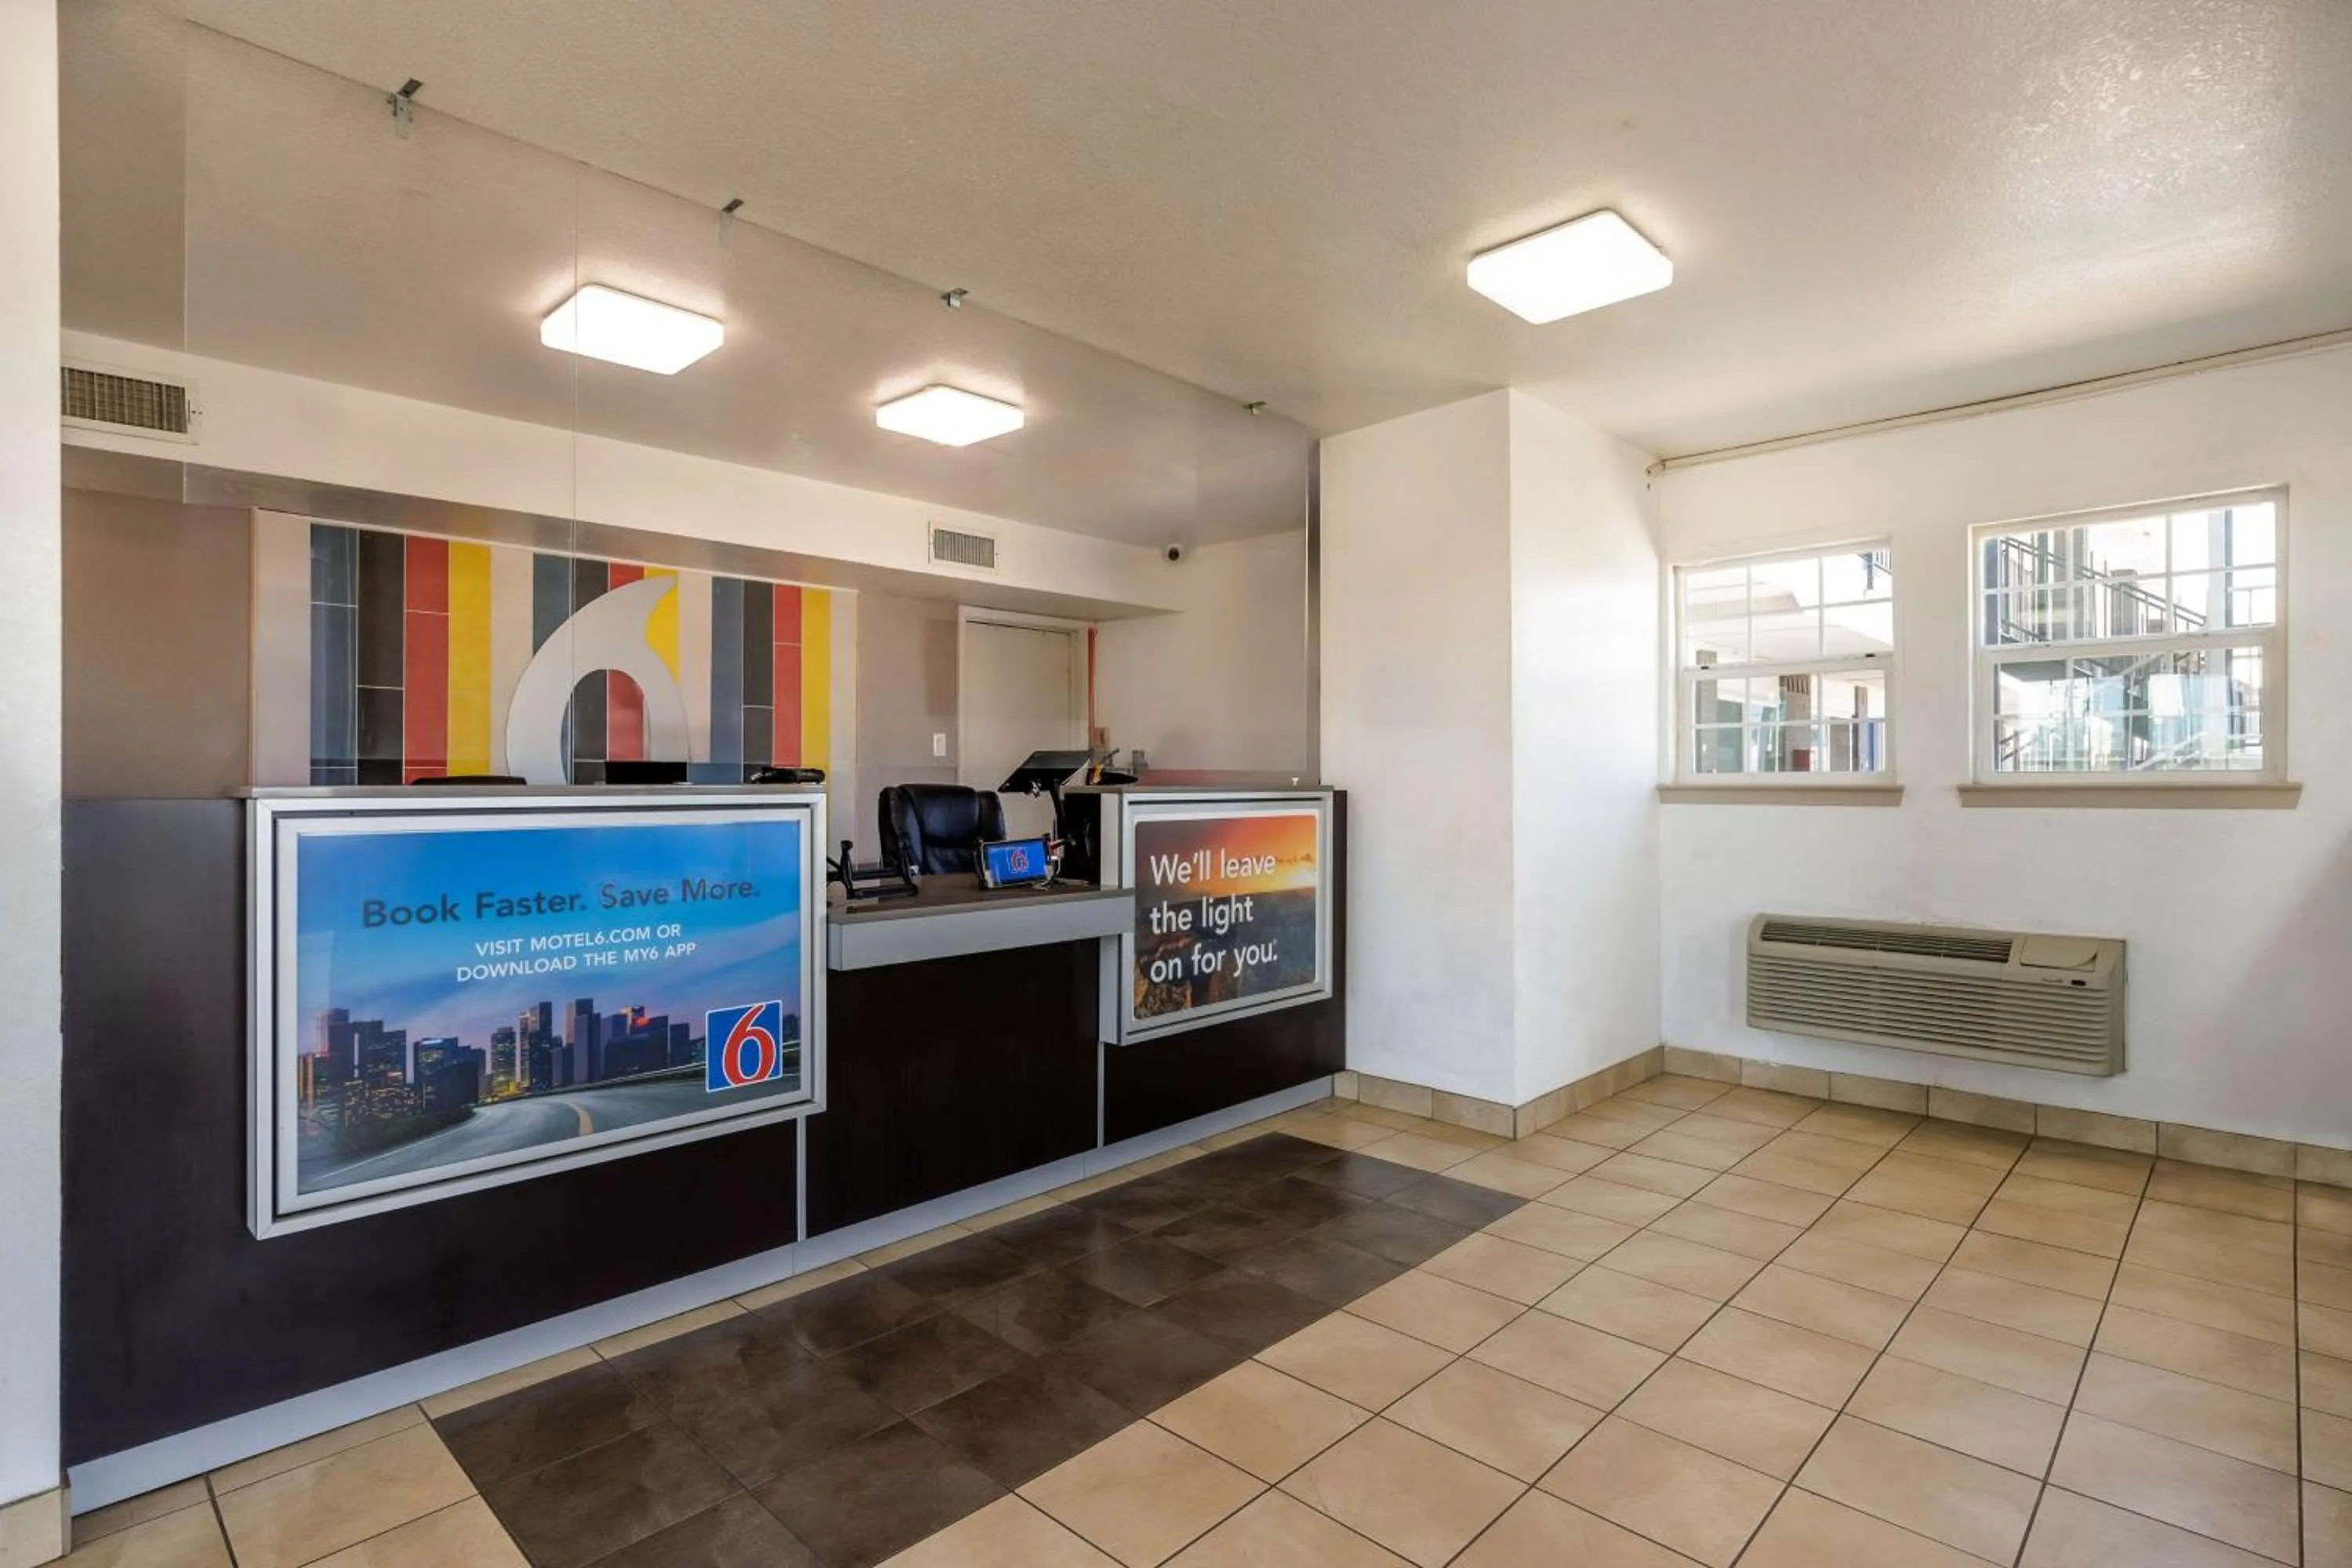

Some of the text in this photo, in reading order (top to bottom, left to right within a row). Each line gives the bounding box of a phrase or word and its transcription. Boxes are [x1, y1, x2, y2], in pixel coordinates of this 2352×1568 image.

[1150, 848, 1276, 886] We'll leave
[363, 877, 760, 928] Book Faster. Save More.
[1149, 894, 1254, 935] the light
[475, 924, 681, 957] VISIT MOTEL6.COM OR
[456, 942, 696, 982] DOWNLOAD THE MY6 APP
[1150, 942, 1279, 983] on for you.
[722, 1002, 776, 1087] 6
